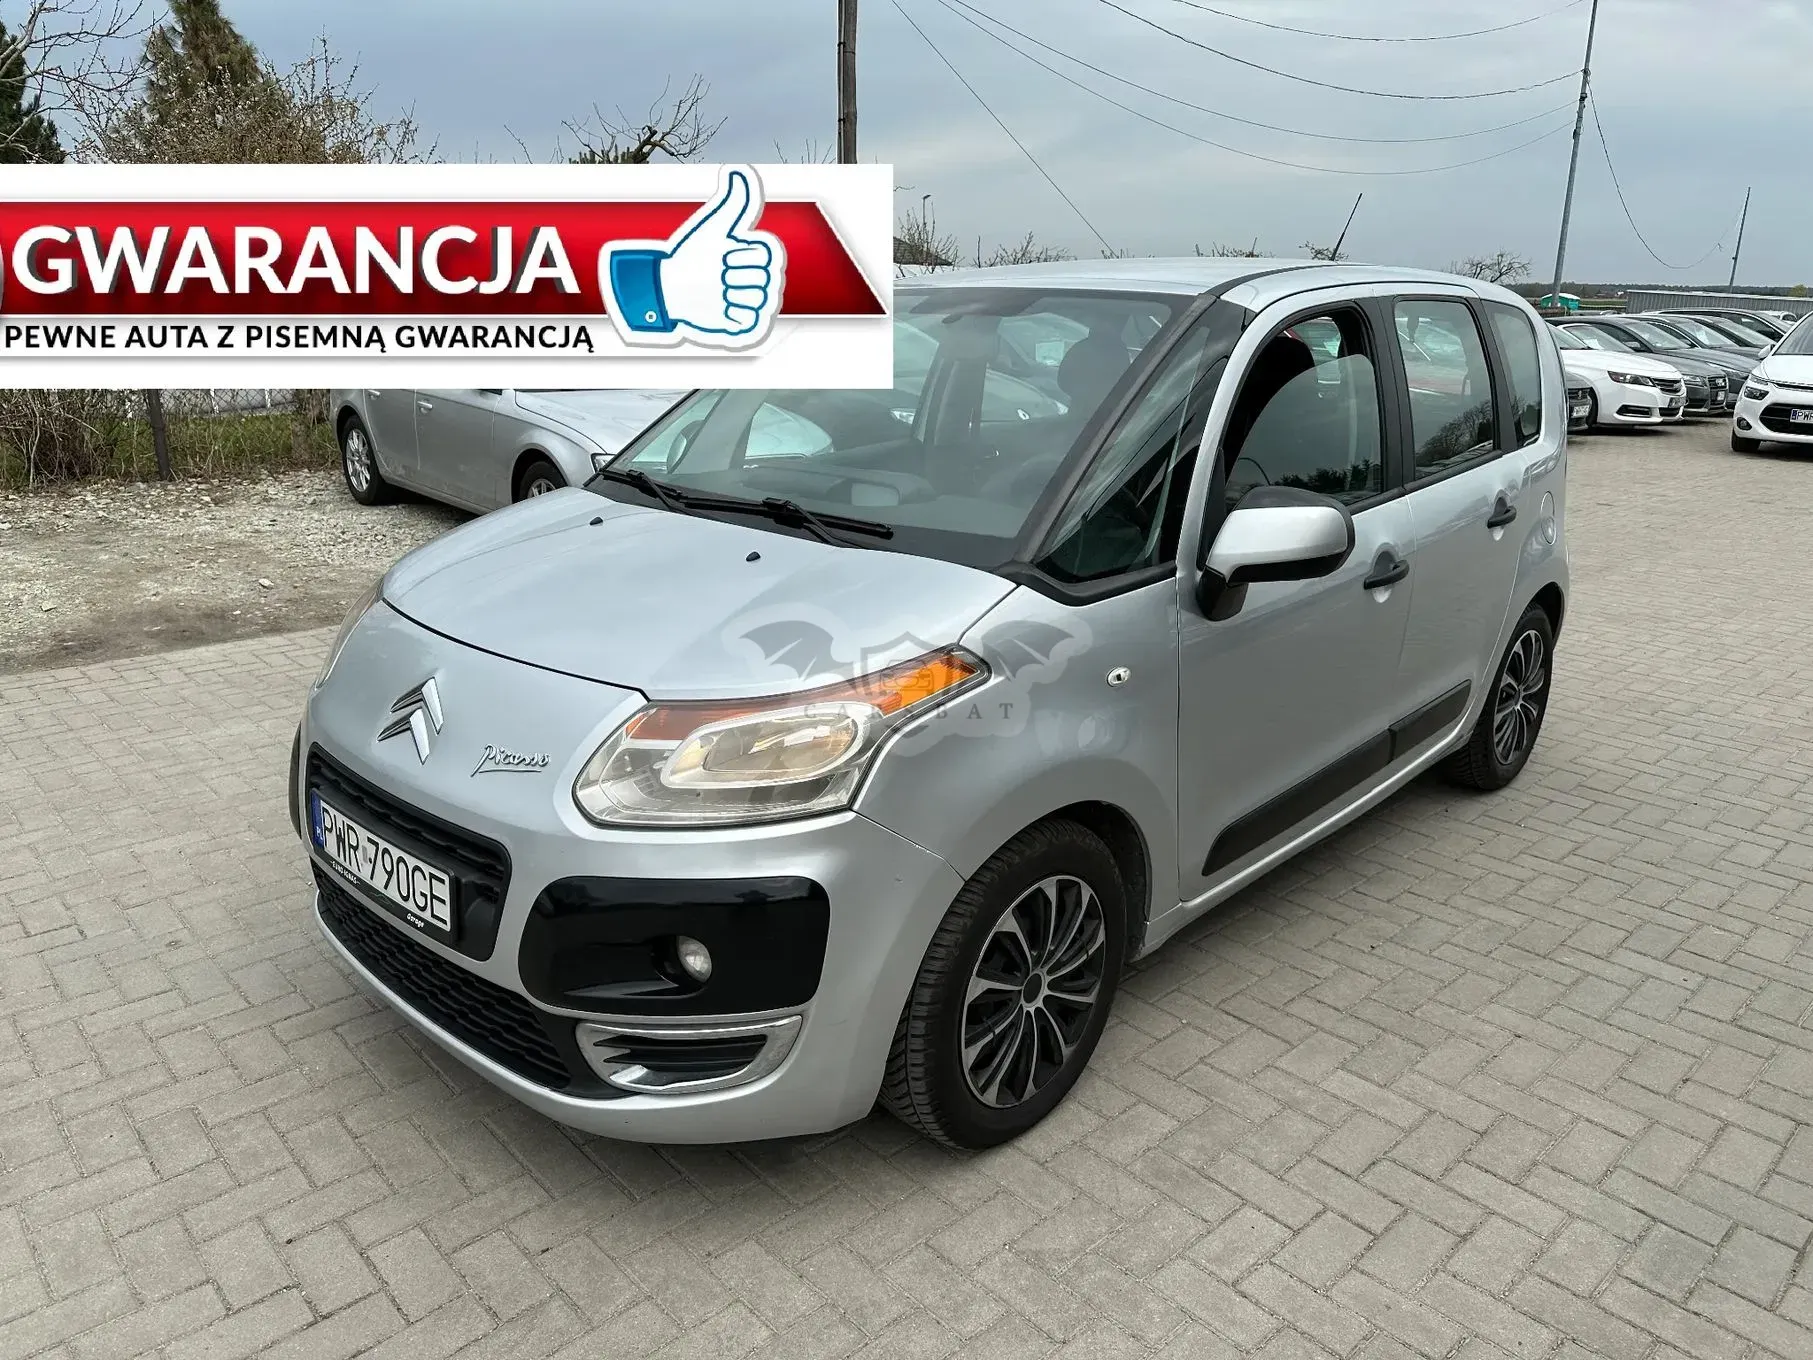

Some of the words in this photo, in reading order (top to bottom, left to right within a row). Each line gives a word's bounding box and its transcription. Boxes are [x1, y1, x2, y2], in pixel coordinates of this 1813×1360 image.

[470, 743, 550, 777] Picasso
[322, 806, 362, 873] PWR
[366, 835, 448, 926] 790GE
